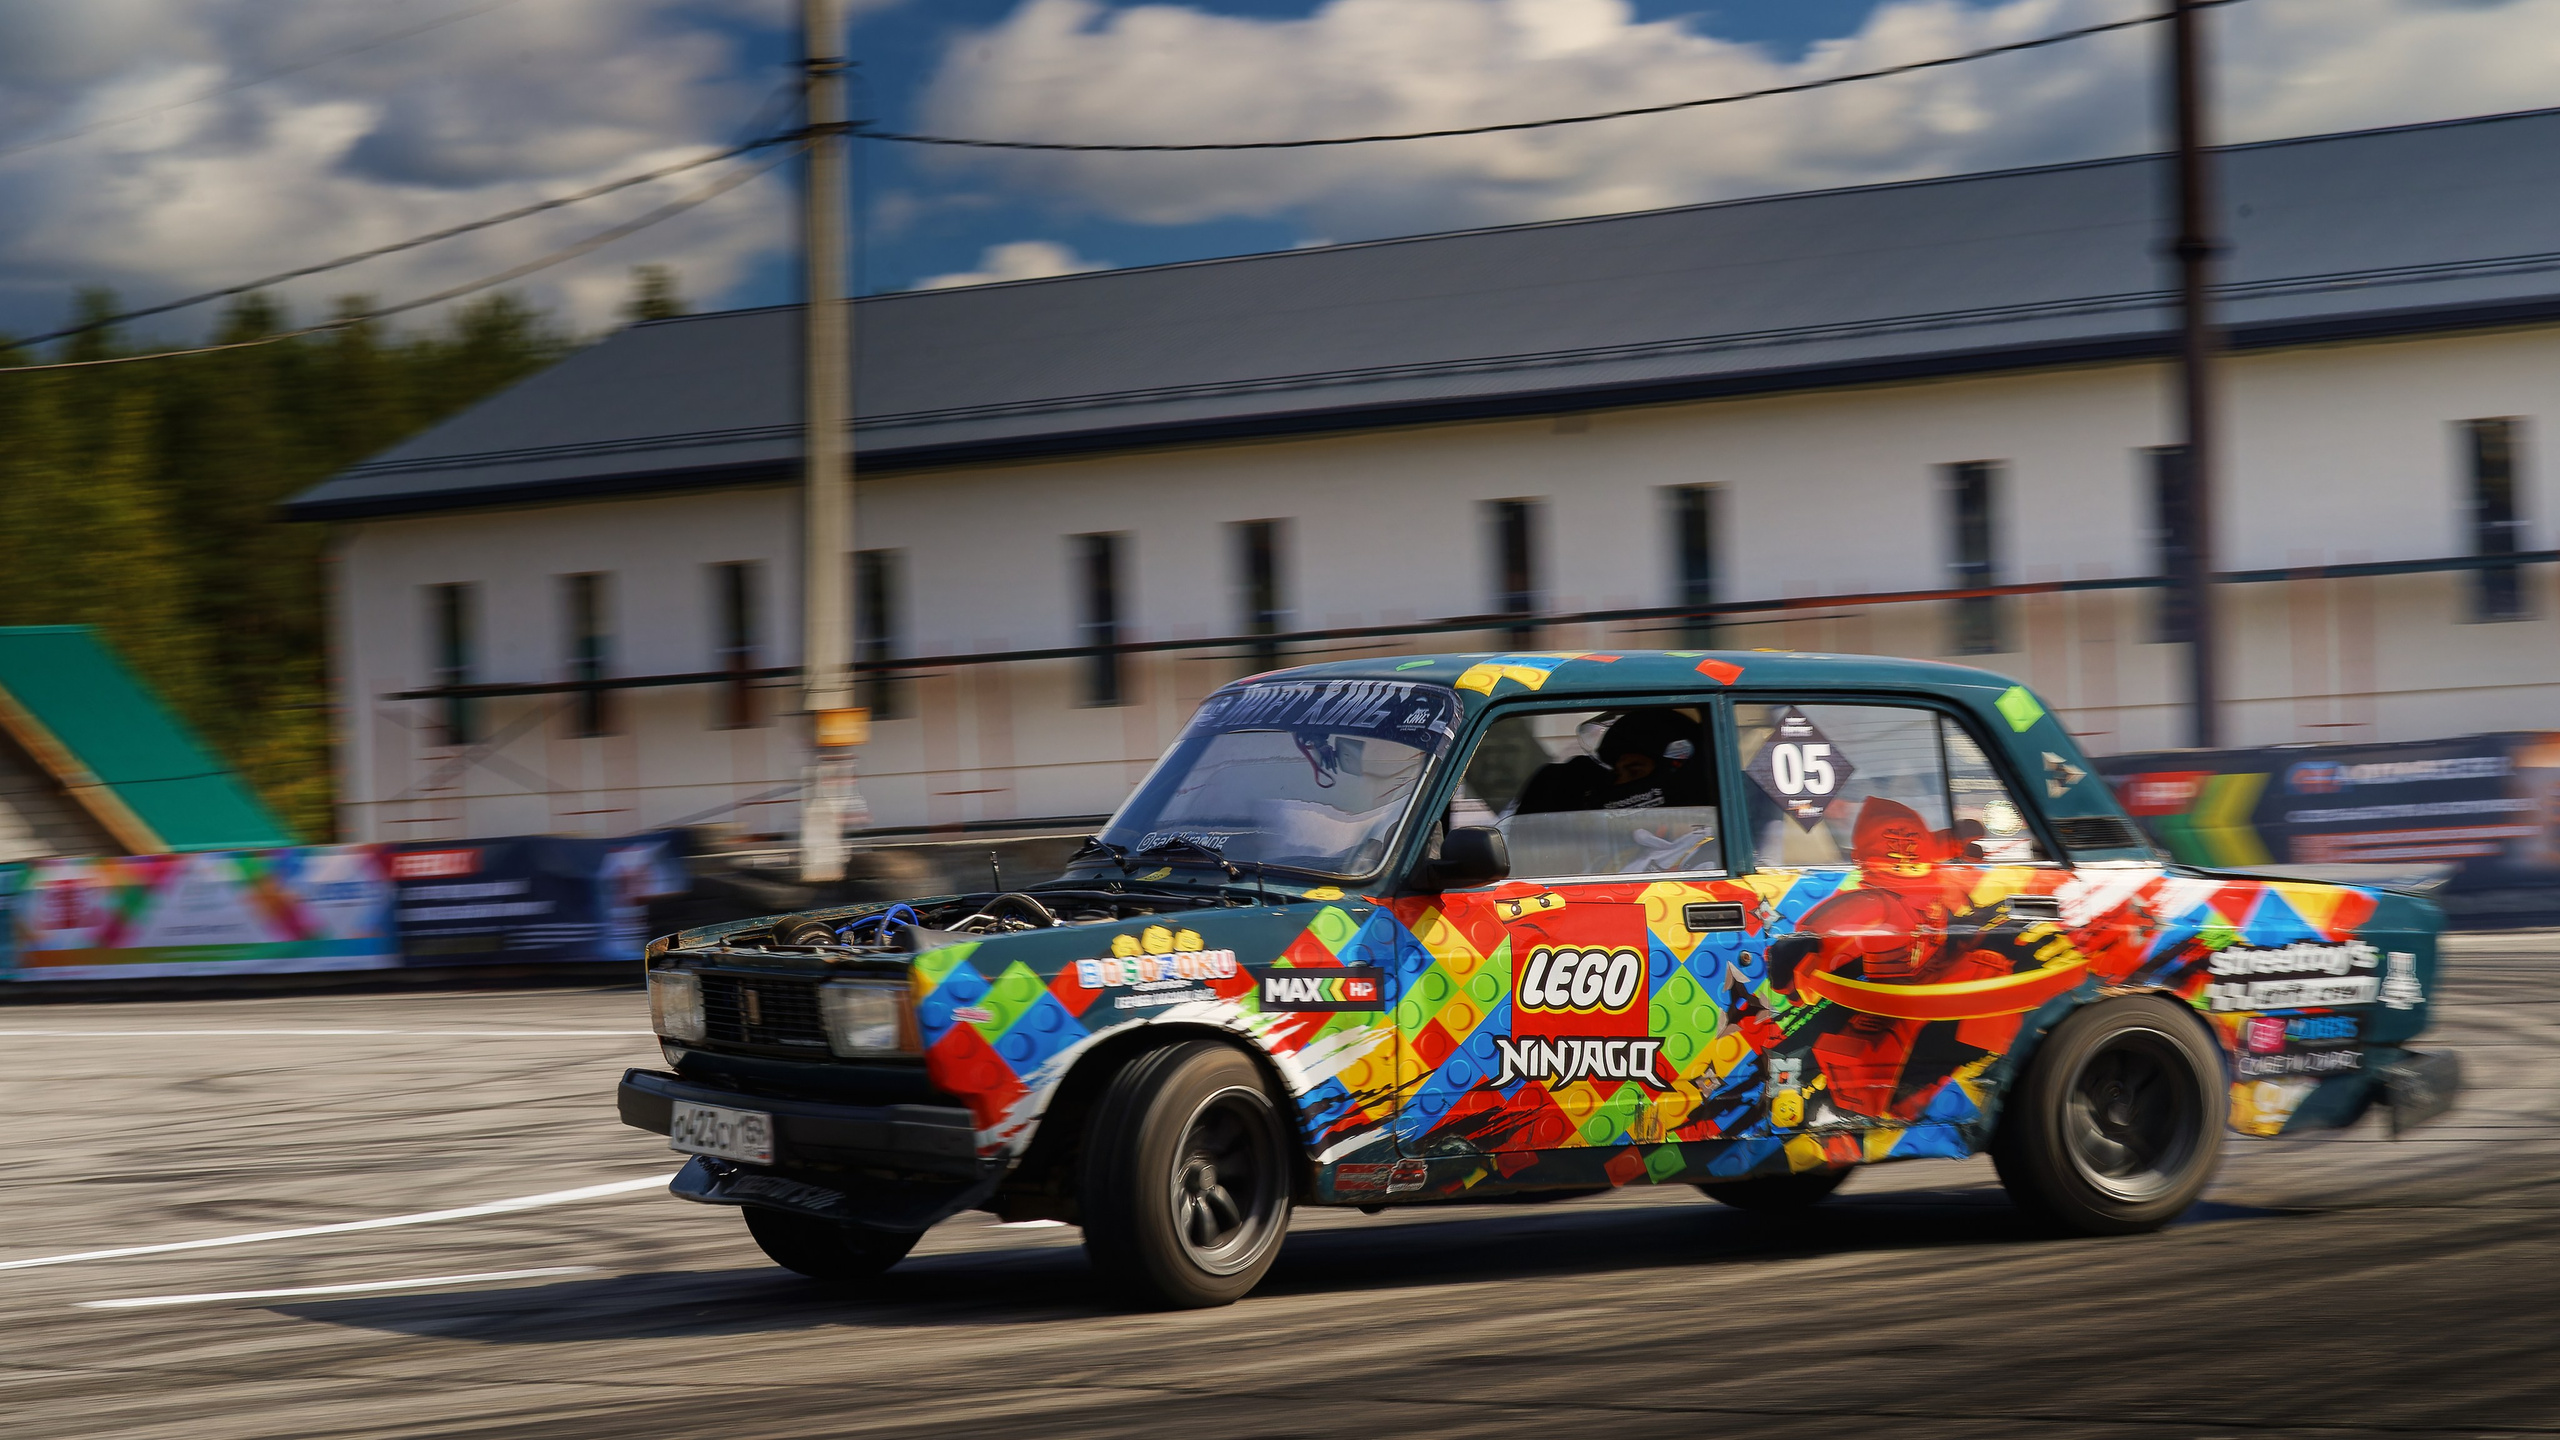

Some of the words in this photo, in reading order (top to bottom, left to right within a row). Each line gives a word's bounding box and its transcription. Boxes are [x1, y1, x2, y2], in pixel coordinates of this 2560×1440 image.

[1293, 679, 1412, 728] KING
[1772, 743, 1836, 795] 05
[1265, 978, 1324, 1002] MAX
[1349, 982, 1374, 997] HP
[1520, 950, 1641, 1010] LEGO
